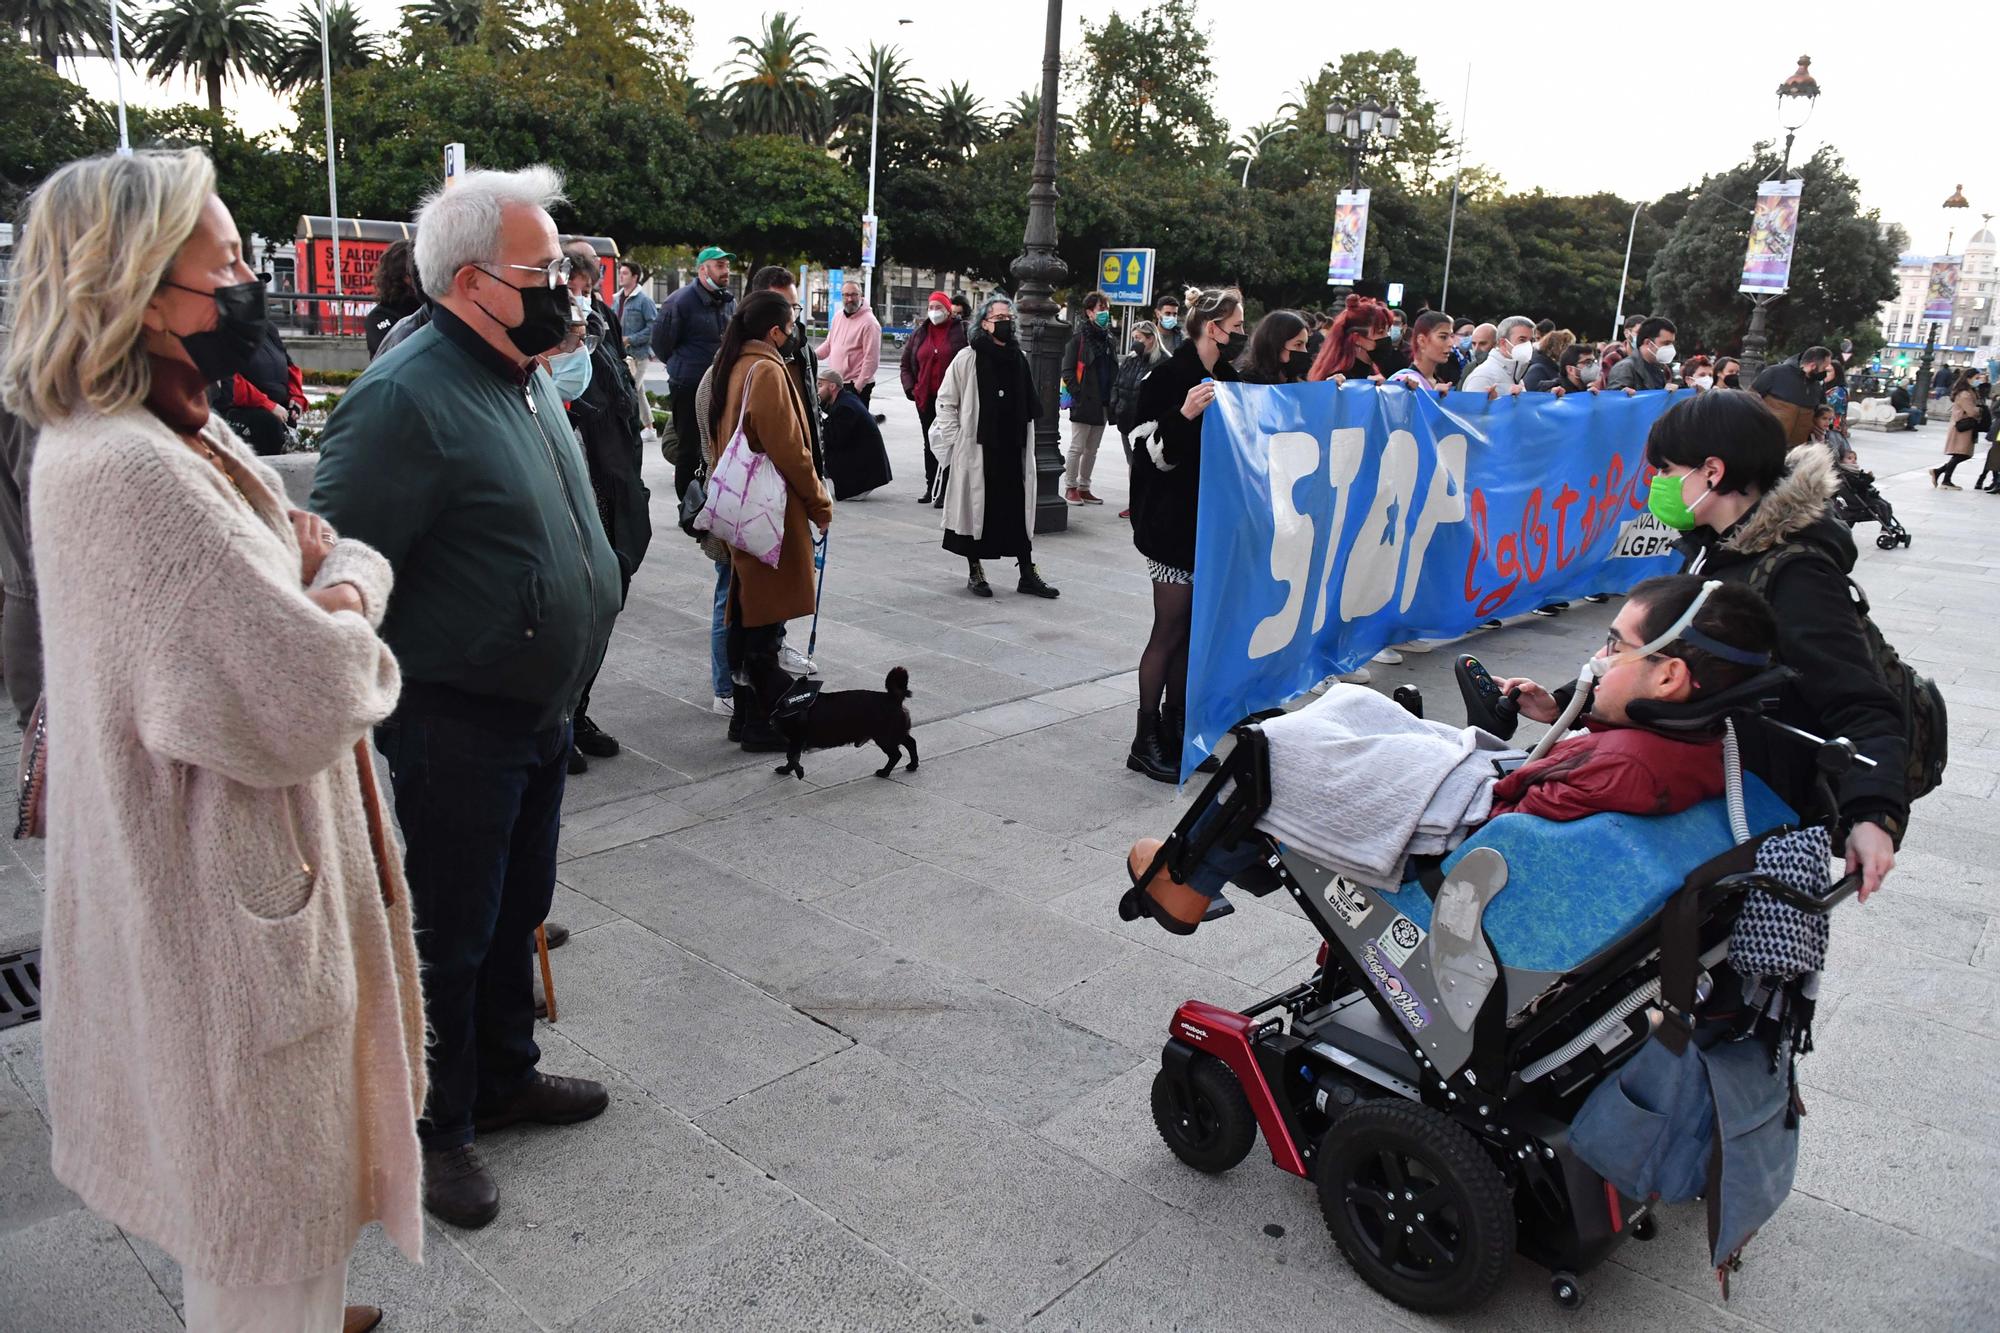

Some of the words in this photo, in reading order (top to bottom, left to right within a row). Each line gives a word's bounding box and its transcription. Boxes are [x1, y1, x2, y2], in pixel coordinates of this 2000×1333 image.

[447, 149, 453, 174] P
[1248, 427, 1468, 660] STOP
[1621, 535, 1674, 556] LGBT+
[1329, 894, 1352, 922] blues
[1398, 919, 1418, 941] SONS
[1394, 991, 1425, 1028] Blues
